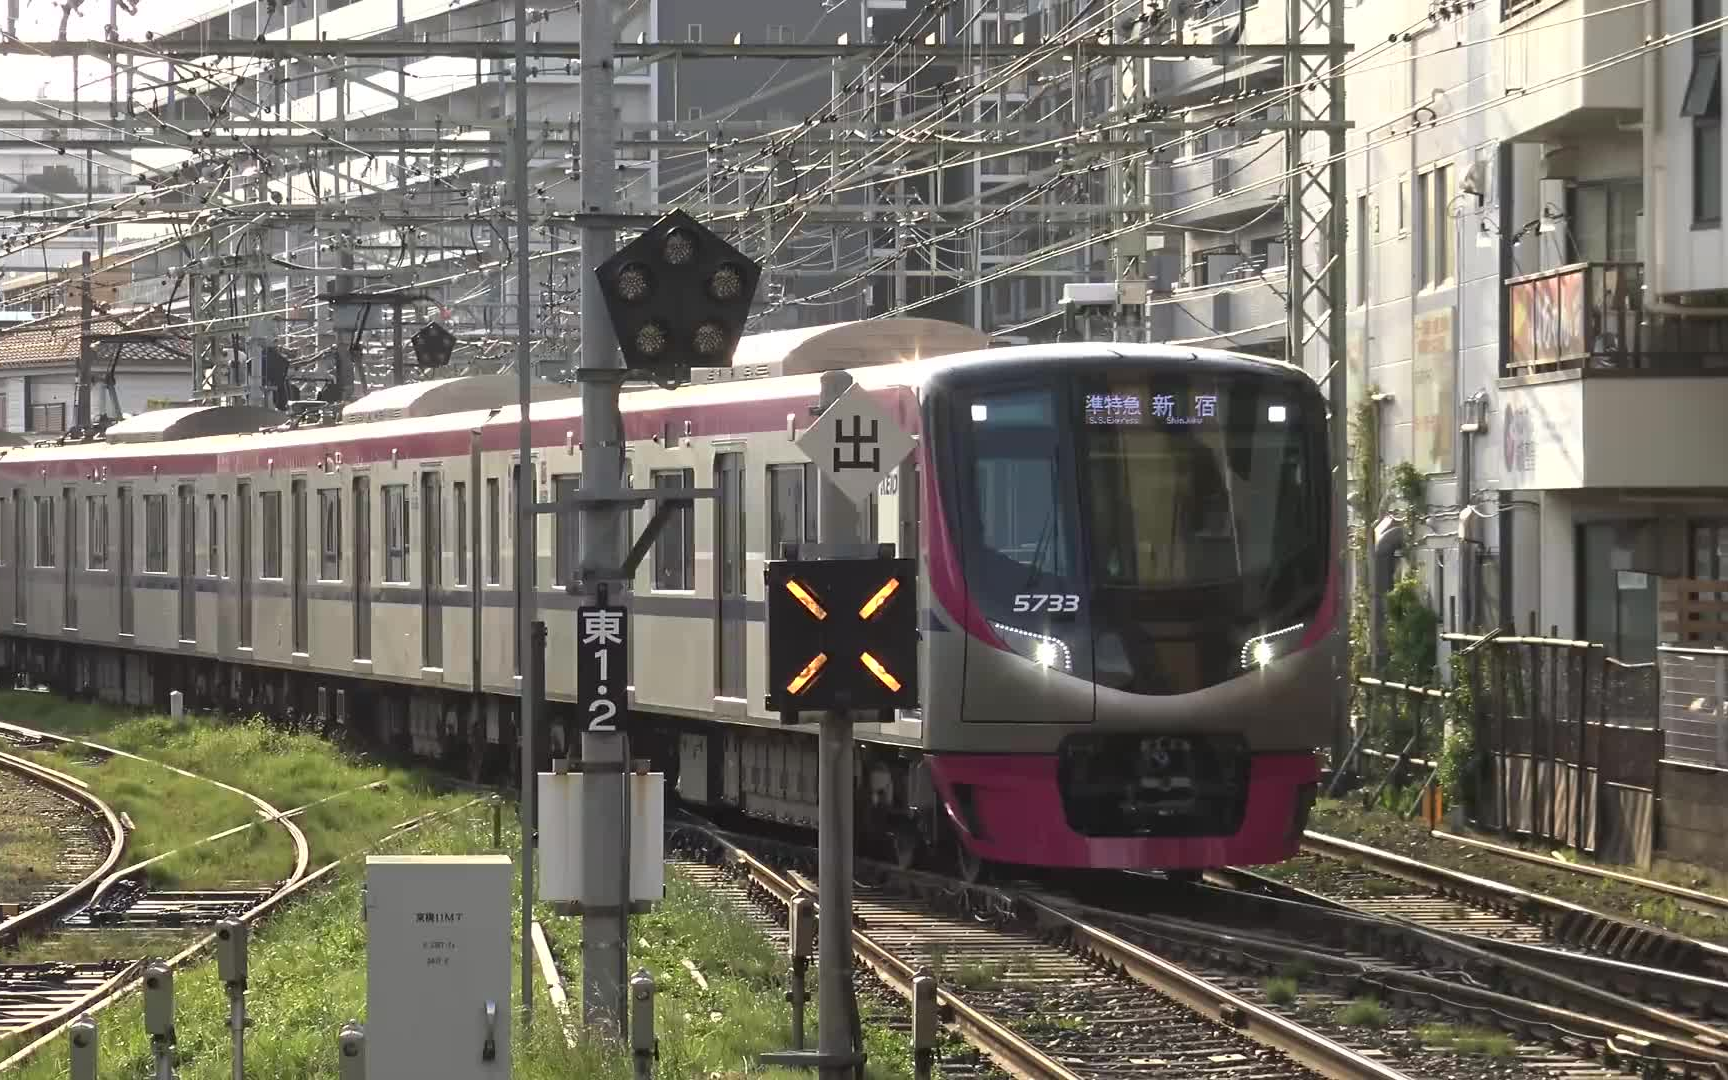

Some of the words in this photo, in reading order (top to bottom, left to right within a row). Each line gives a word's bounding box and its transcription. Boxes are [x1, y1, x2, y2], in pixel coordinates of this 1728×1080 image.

[1085, 394, 1142, 416] 準特急
[833, 415, 880, 473] 出
[1013, 594, 1080, 612] 5733
